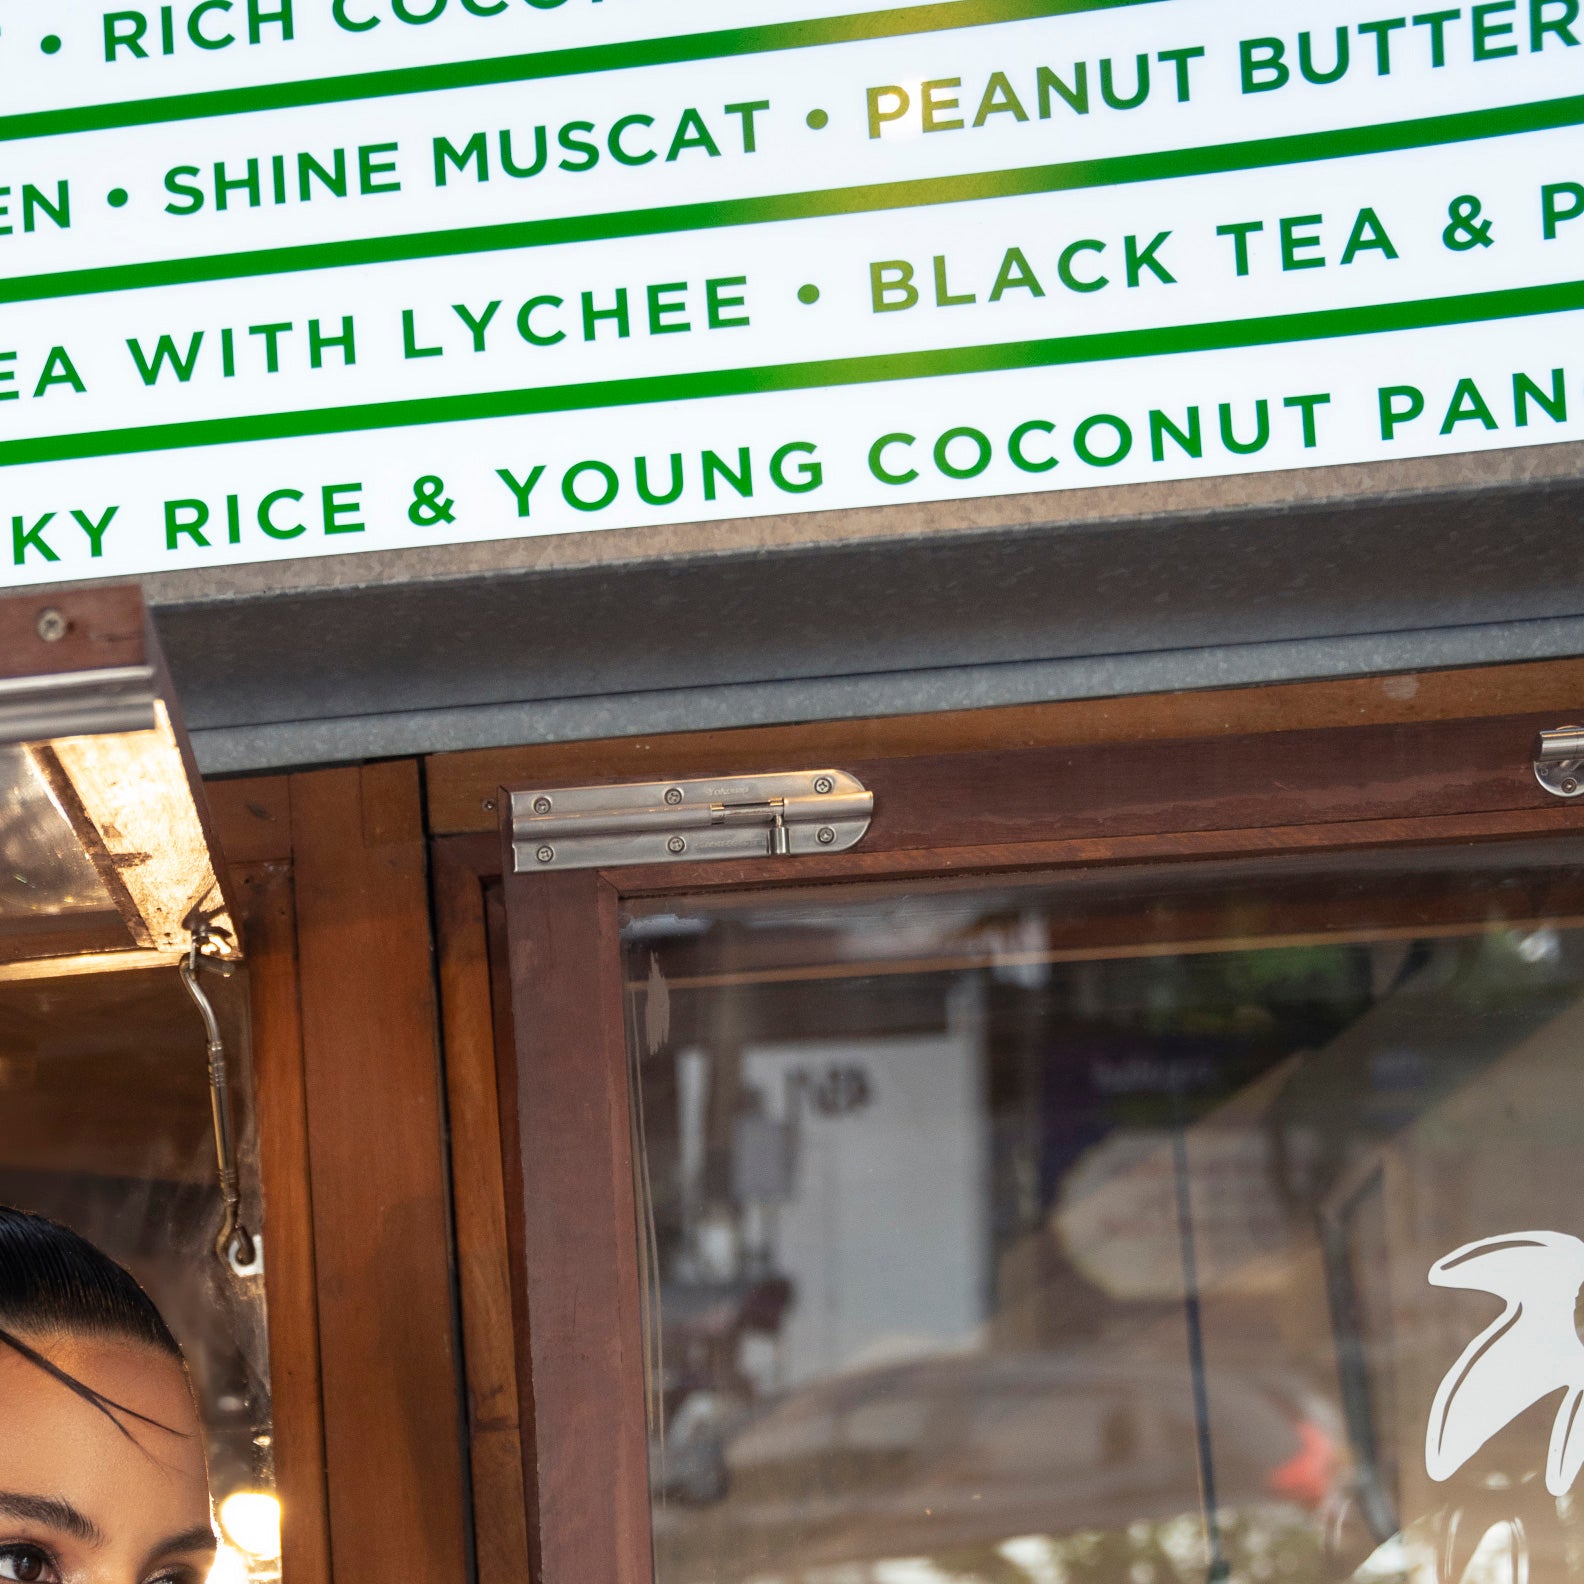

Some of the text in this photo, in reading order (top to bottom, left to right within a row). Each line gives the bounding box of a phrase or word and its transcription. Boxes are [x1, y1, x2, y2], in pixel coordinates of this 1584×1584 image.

[103, 0, 295, 63] RICH
[866, 0, 1580, 139] PEANUT BUTTER
[163, 99, 770, 216] SHINE MUSCAT
[869, 230, 1177, 313] BLACK
[1215, 207, 1399, 277] TEA
[1441, 194, 1495, 252] &
[125, 315, 357, 387] WITH
[401, 275, 751, 360] LYCHEE
[163, 481, 366, 551] RICE
[407, 474, 456, 527] &
[495, 440, 824, 518] YOUNG
[867, 392, 1331, 486] COCONUT
